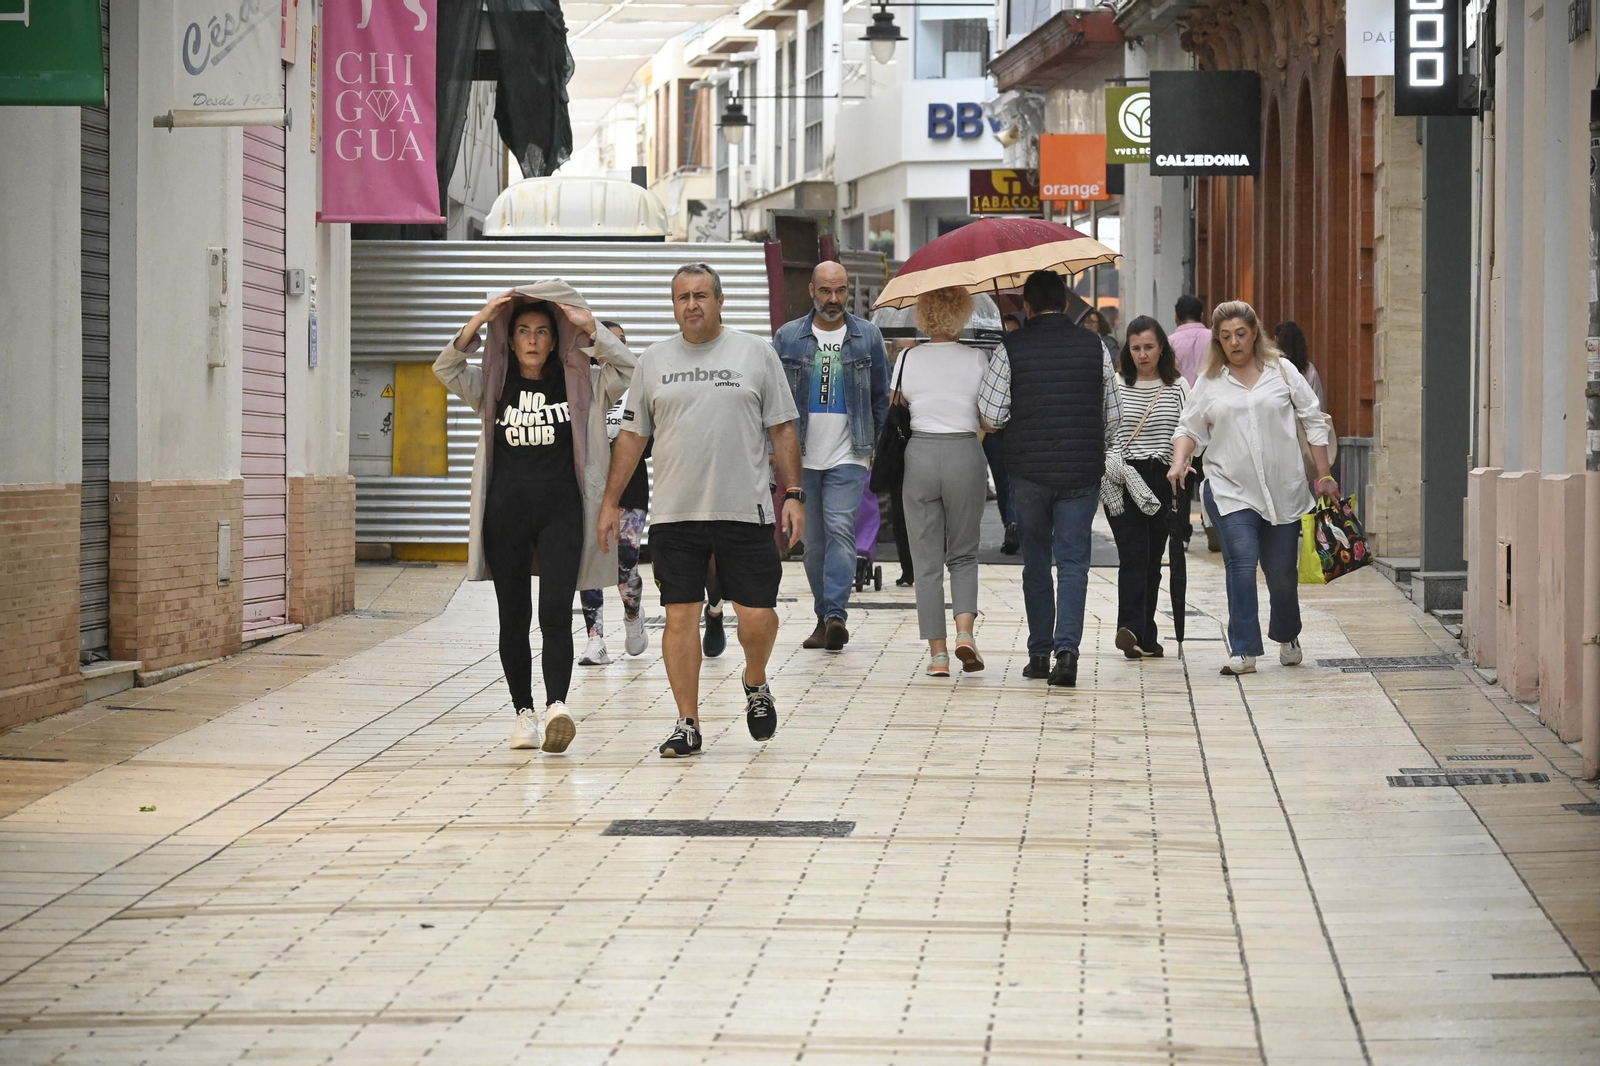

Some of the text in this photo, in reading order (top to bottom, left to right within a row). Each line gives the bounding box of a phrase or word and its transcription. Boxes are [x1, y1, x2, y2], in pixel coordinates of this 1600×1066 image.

[335, 52, 413, 86] CHI
[192, 92, 284, 106] Desde 192
[335, 129, 425, 162] GUA
[1156, 154, 1250, 166] CALZEDONIA
[1043, 183, 1100, 199] orange
[974, 196, 1040, 208] TABACOS
[662, 367, 732, 385] umbro
[715, 380, 741, 388] umbro
[820, 356, 830, 404] MOTEL
[519, 390, 546, 413] NO
[505, 425, 555, 447] CLUB
